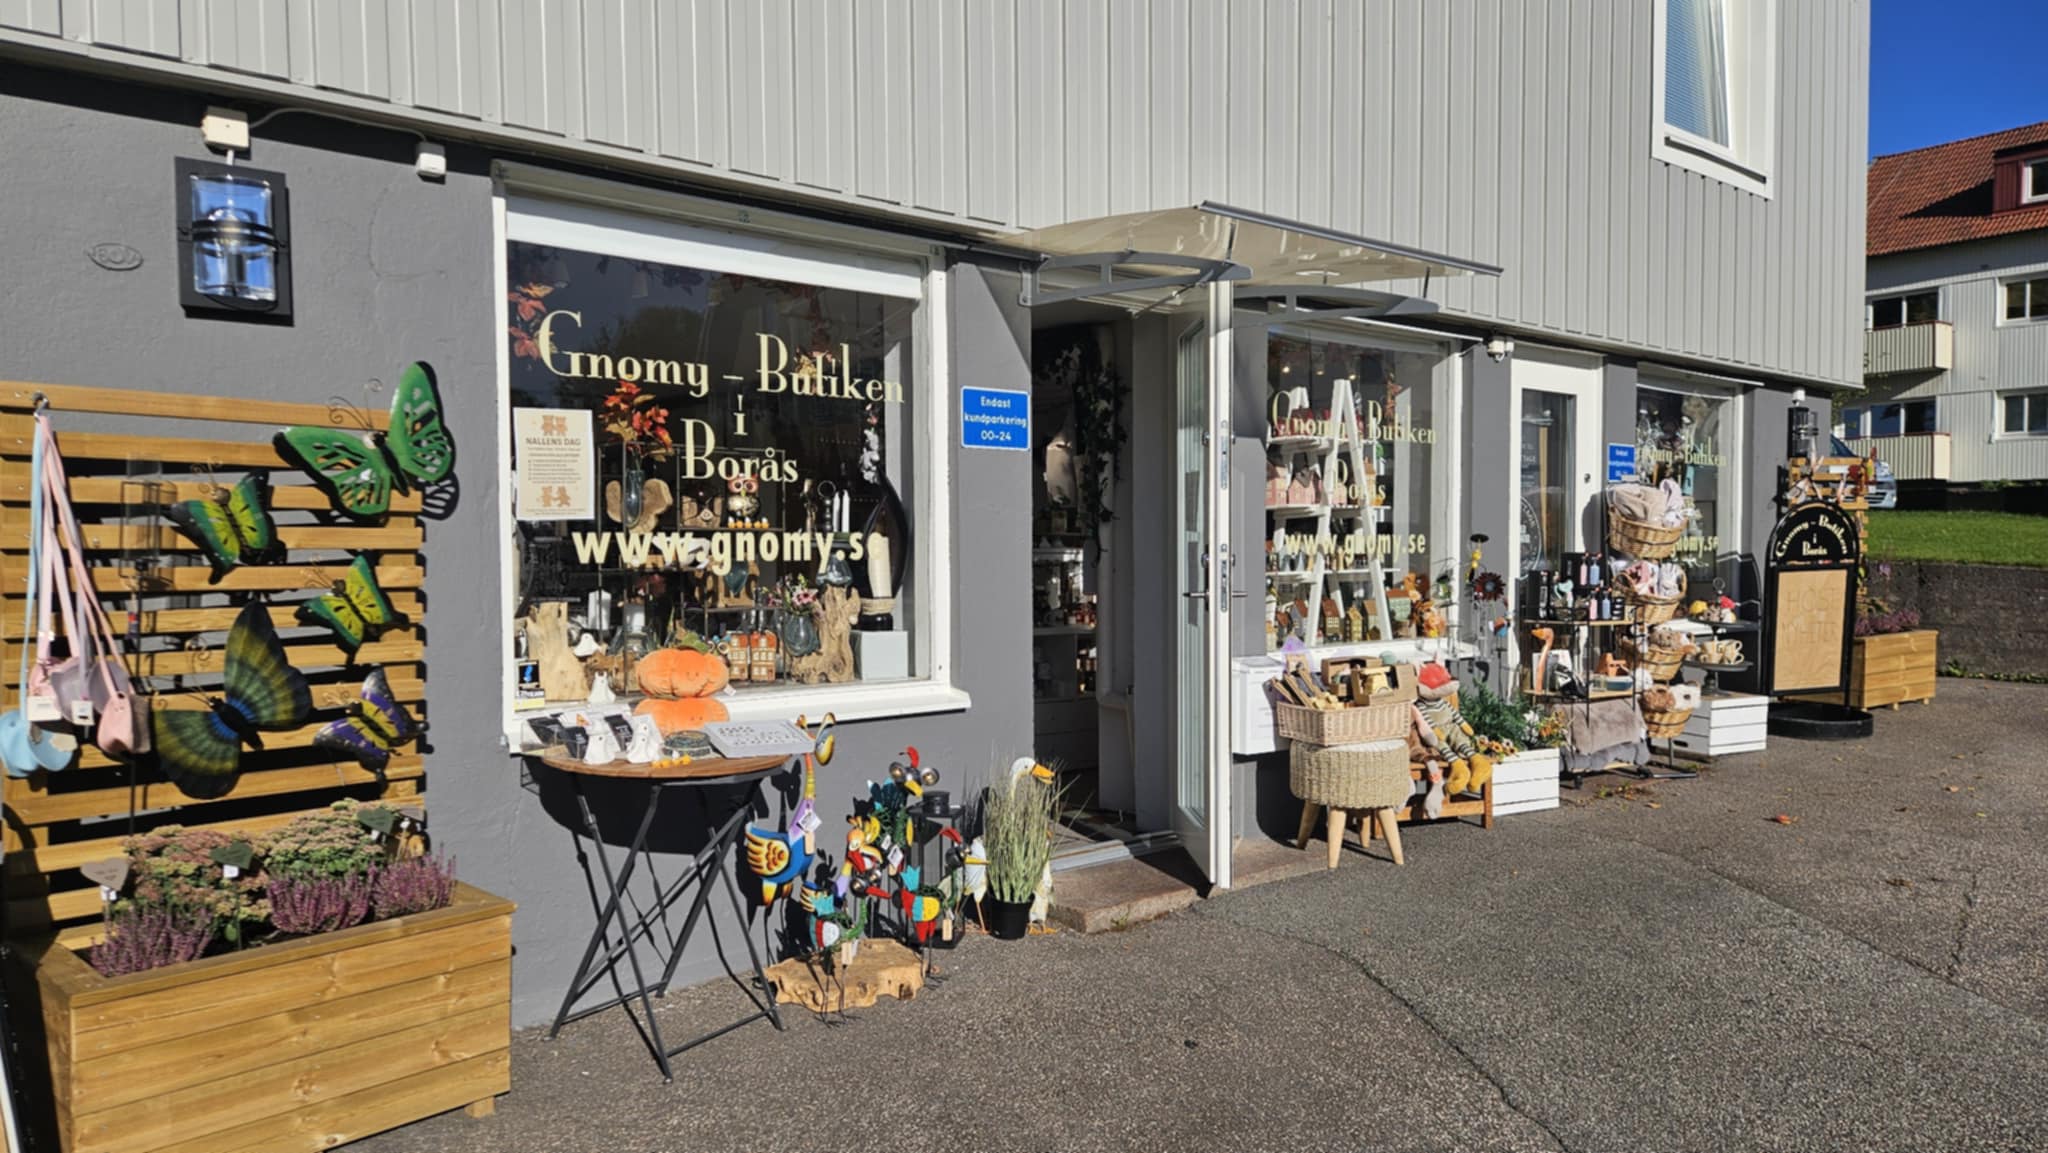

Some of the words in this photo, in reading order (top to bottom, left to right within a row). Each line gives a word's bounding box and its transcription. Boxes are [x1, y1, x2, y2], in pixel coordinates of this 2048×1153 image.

[538, 309, 709, 397] Gnomy
[756, 332, 904, 403] Butiken
[980, 395, 1011, 408] Endast
[964, 412, 1027, 428] kundparkering
[526, 437, 562, 446] NALLENS
[564, 438, 581, 446] DAG
[981, 429, 1011, 441] 00-24
[680, 418, 799, 484] Borås
[572, 531, 885, 576] www.gnomy.se
